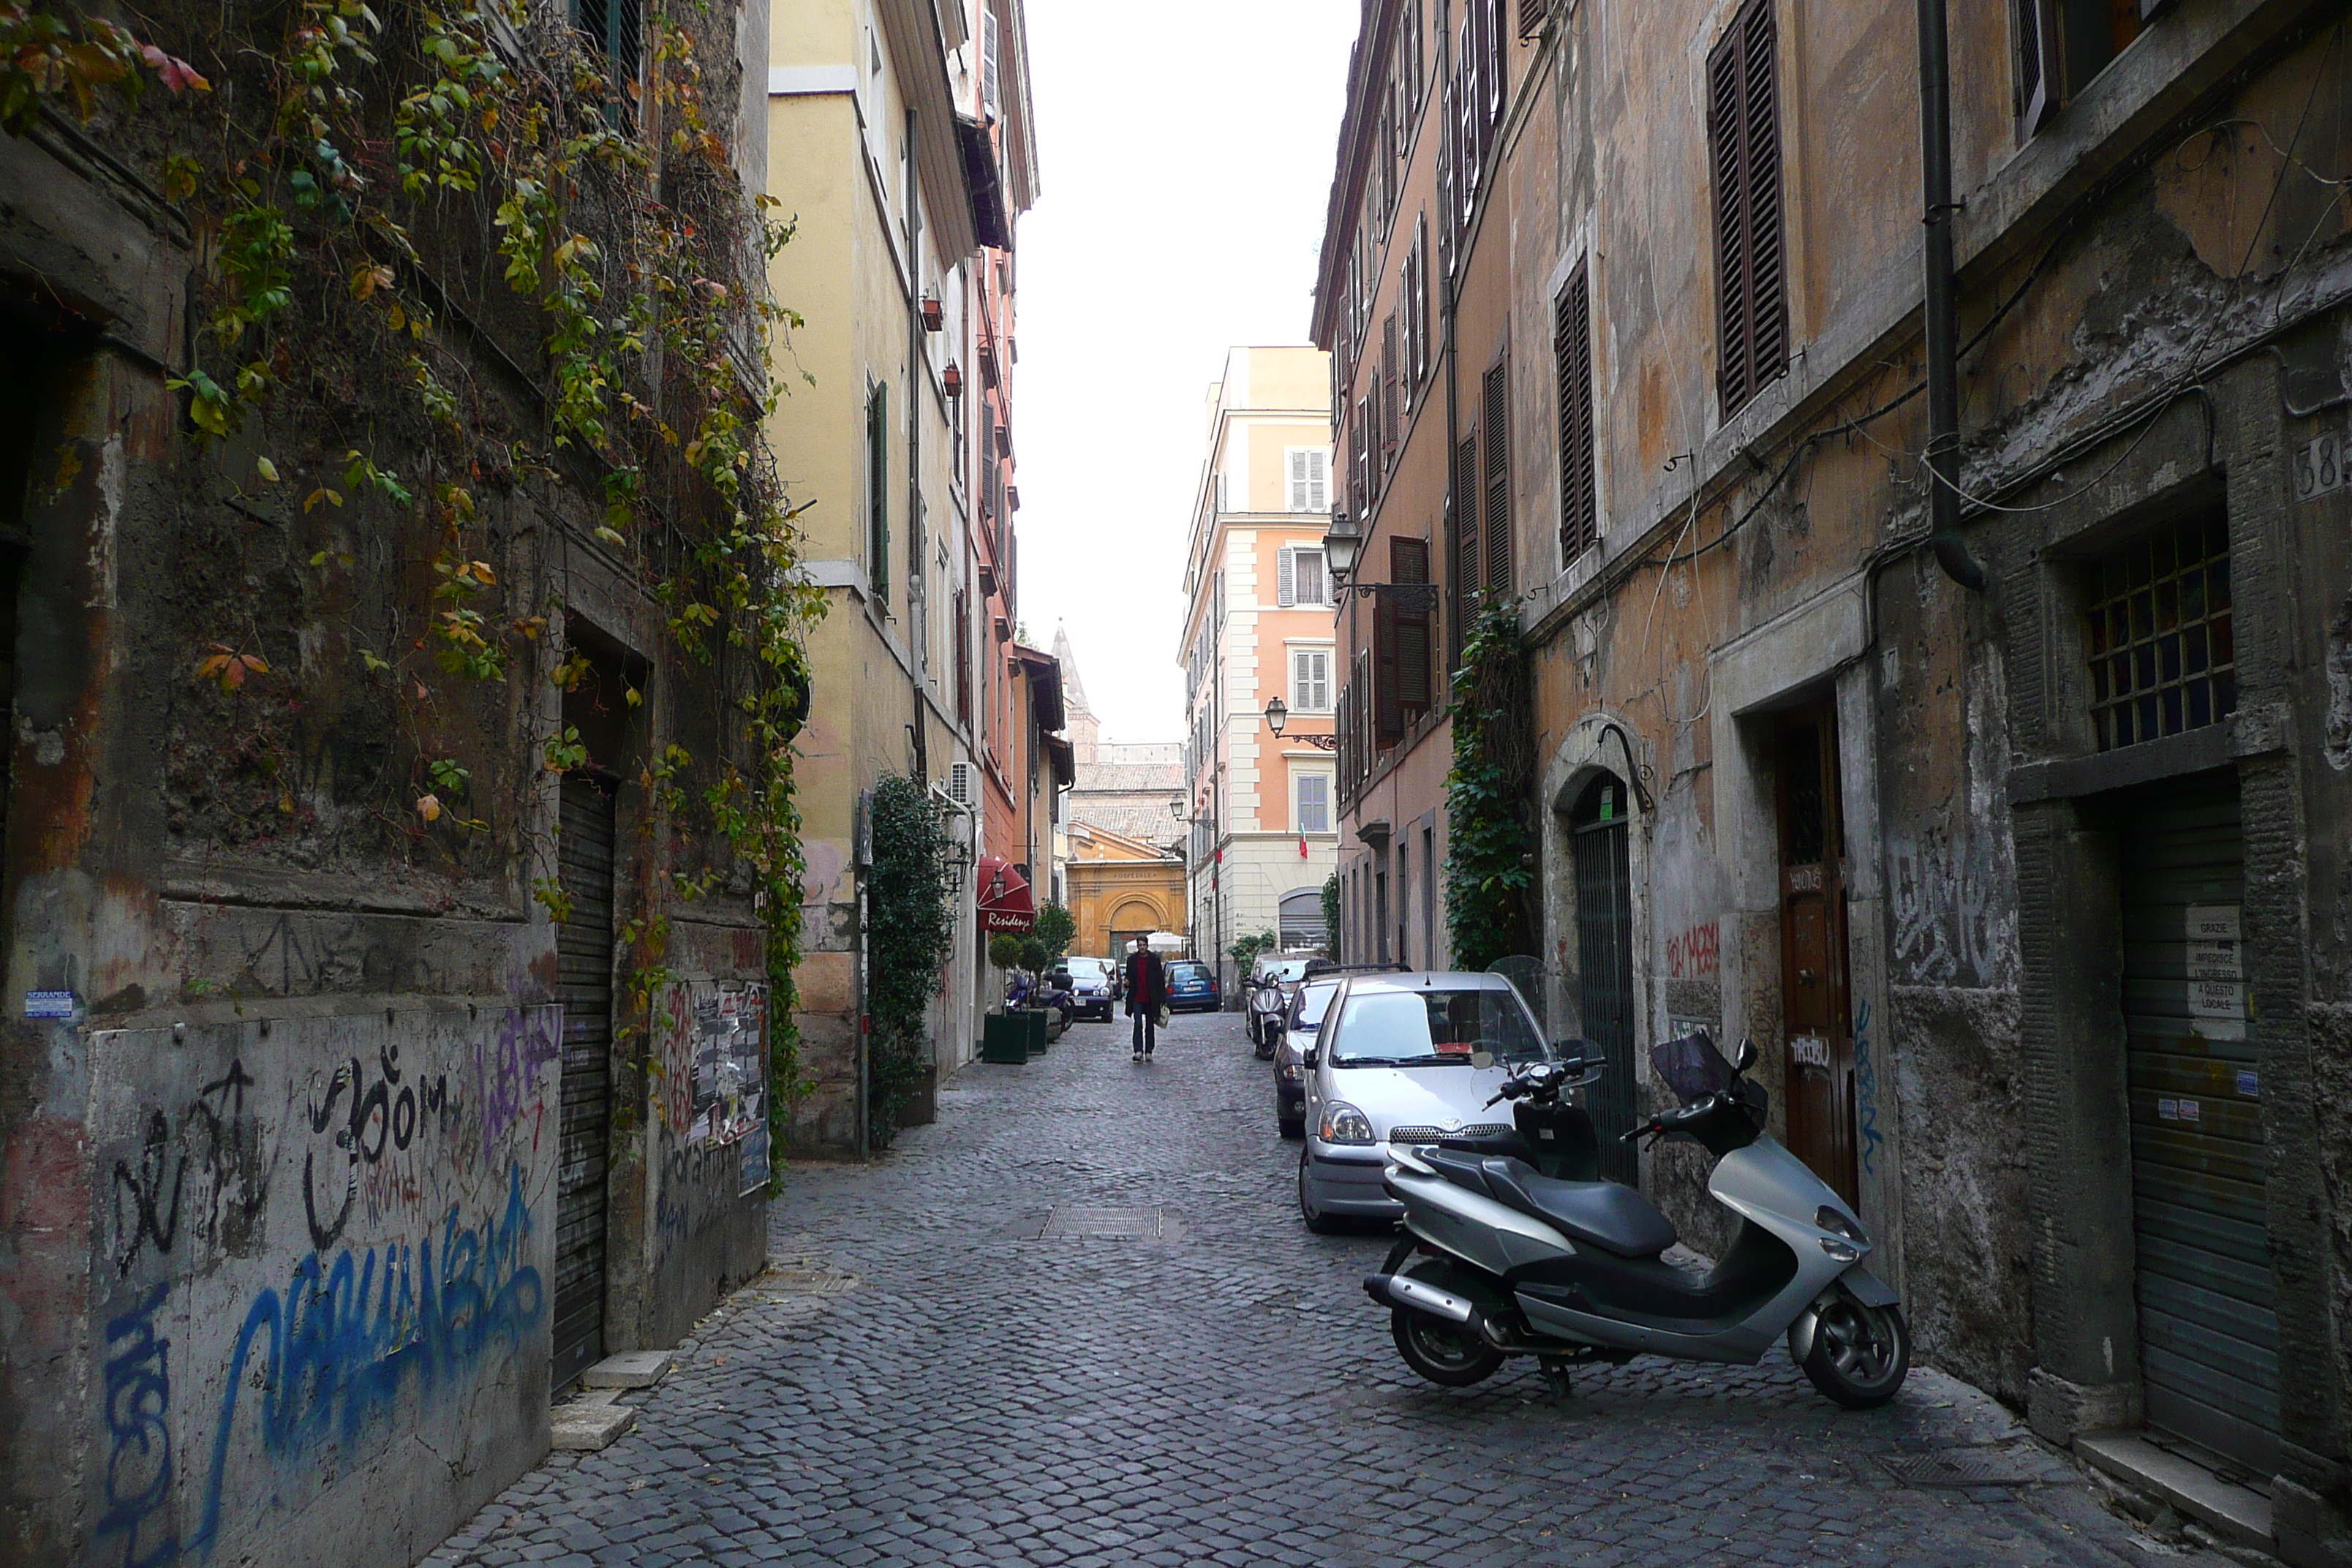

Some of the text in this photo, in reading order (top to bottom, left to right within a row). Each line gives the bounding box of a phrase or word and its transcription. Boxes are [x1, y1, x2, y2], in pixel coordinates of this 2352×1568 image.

[2201, 923, 2228, 933] GRAZIE
[2195, 953, 2234, 964] IMPEDISCE
[2195, 969, 2237, 979] L'INGRESSO
[2198, 984, 2234, 995] A QUESTO
[2201, 998, 2231, 1010] LOCALE
